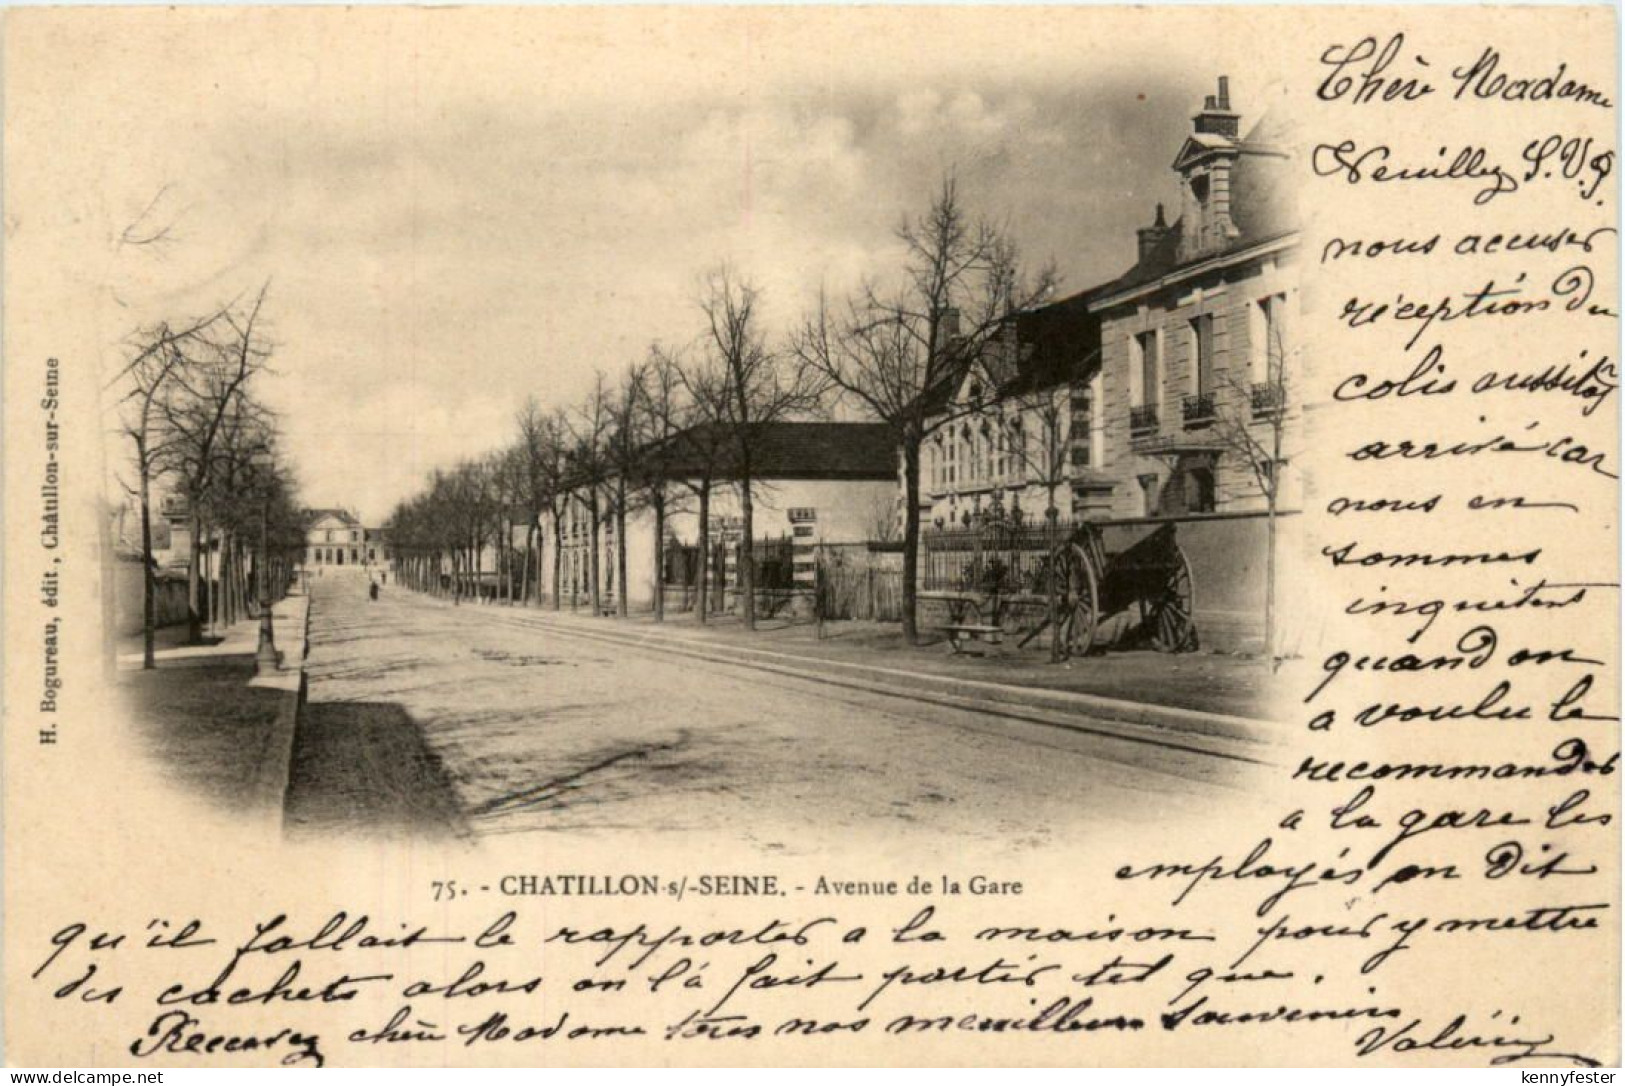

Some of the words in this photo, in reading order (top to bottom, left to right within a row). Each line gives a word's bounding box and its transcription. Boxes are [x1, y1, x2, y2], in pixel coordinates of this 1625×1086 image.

[1320, 235, 1441, 264] nous
[1339, 273, 1550, 351] réception
[1333, 344, 1457, 401] colis
[40, 357, 59, 549] Châtillon-sur-Seine
[1346, 416, 1549, 460] arrivé
[1327, 495, 1442, 516] nous
[1468, 495, 1579, 512] en
[1321, 542, 1542, 567] sommes
[40, 617, 62, 713] Bogureau,
[1304, 625, 1497, 702] quand
[1508, 648, 1605, 666] on
[1354, 680, 1531, 727] voulu
[39, 723, 57, 744] H.
[1331, 786, 1381, 829] la
[1367, 807, 1530, 869] gare
[1545, 789, 1614, 829] les
[432, 881, 468, 901] 75.
[814, 876, 897, 895] Avenue
[907, 875, 933, 895] de
[942, 875, 961, 895] la
[968, 876, 1024, 895] Gare
[1115, 838, 1364, 916] employés
[476, 911, 516, 947] le
[892, 906, 946, 942] la
[975, 914, 1216, 942] maison
[1230, 914, 1387, 969] pour
[1435, 903, 1610, 933] mettre
[157, 960, 393, 1006] cachets
[402, 962, 542, 997] alors
[573, 977, 626, 993] on
[704, 953, 863, 1017] fait
[774, 1017, 870, 1033] nos
